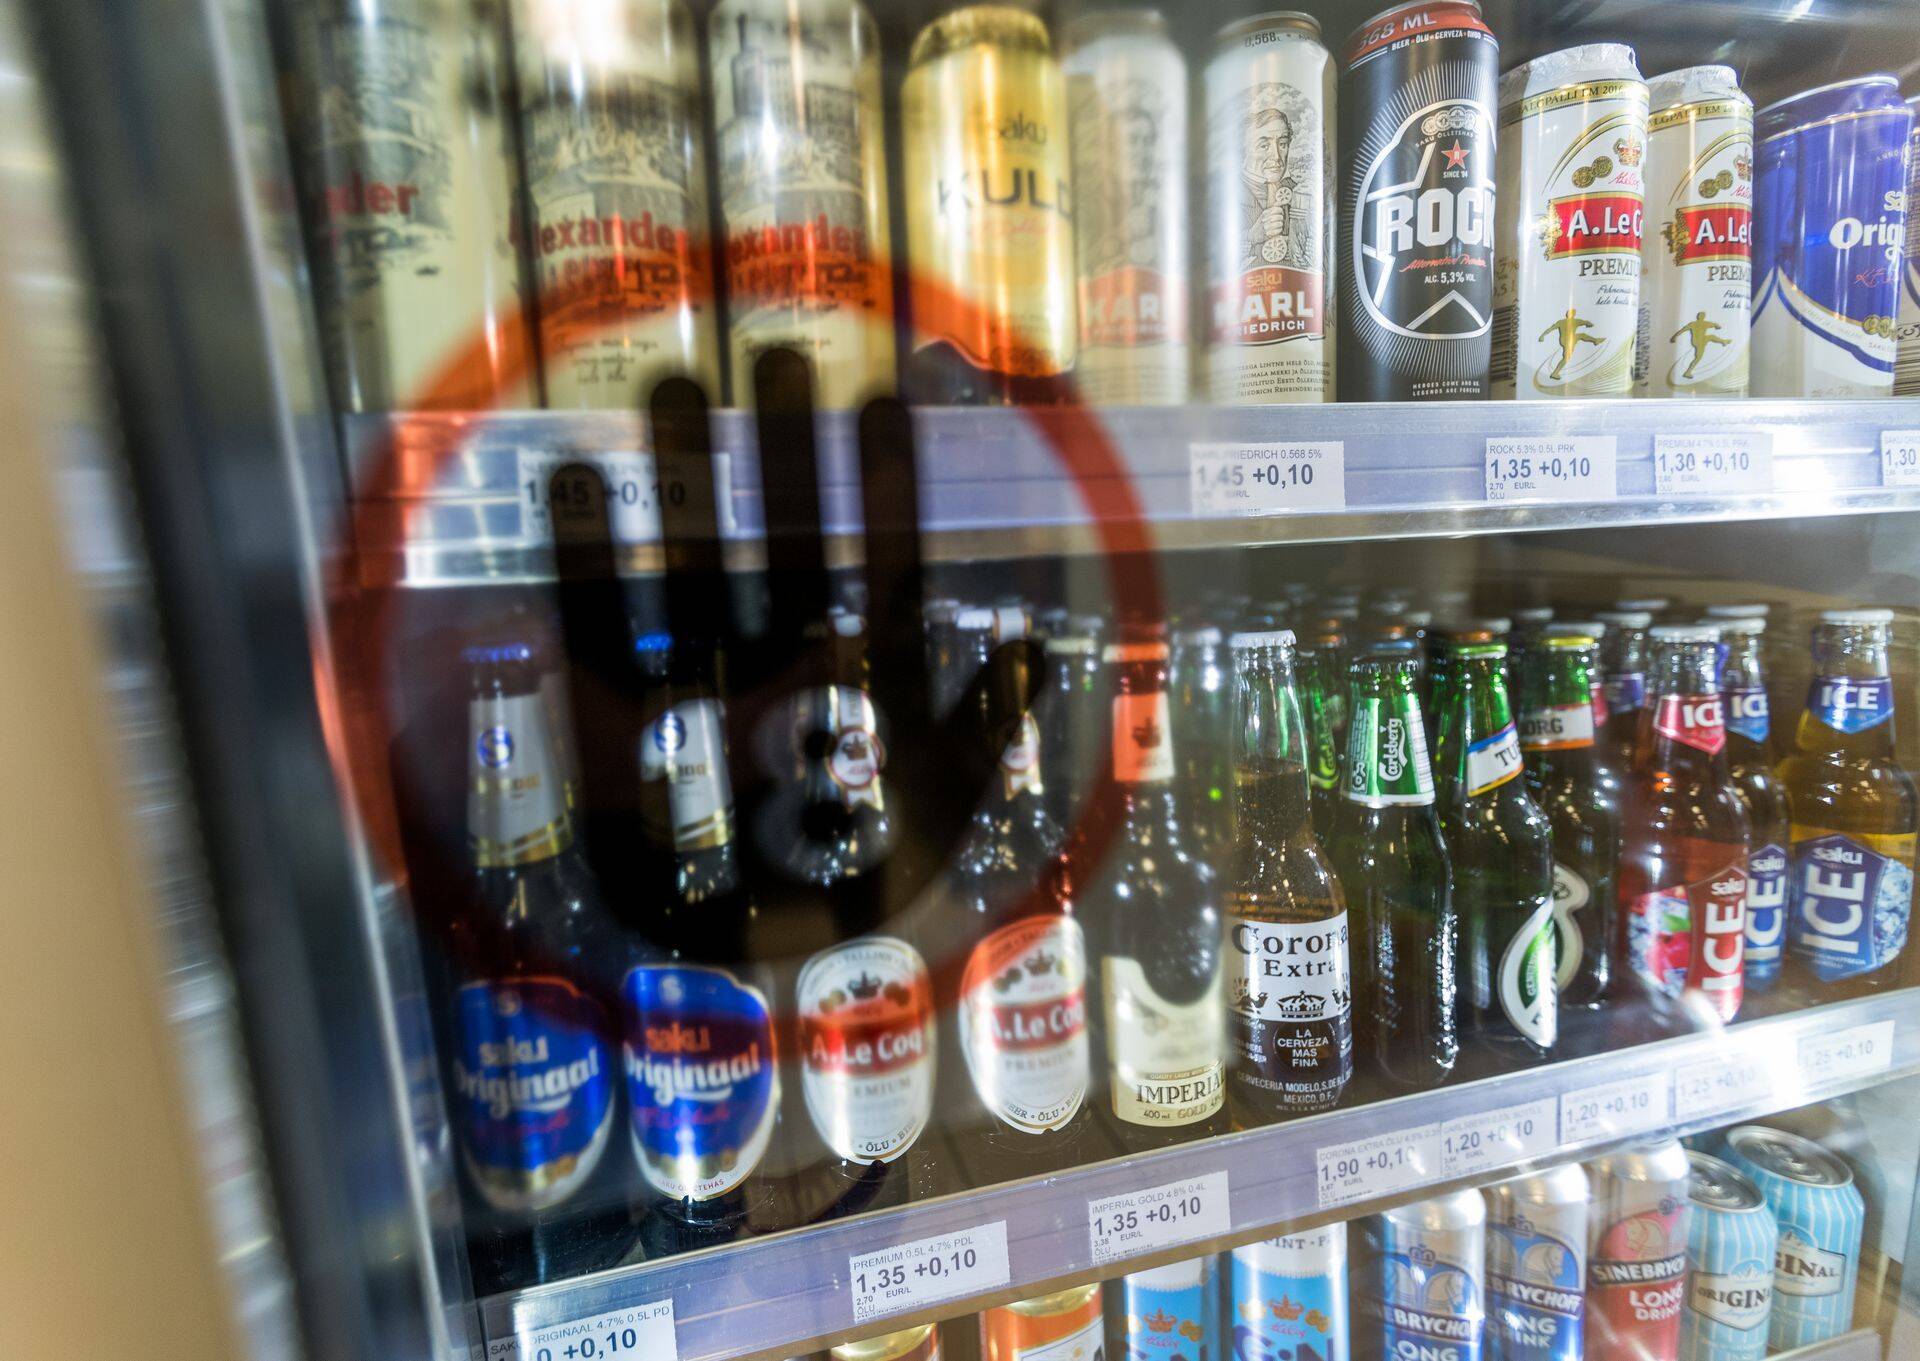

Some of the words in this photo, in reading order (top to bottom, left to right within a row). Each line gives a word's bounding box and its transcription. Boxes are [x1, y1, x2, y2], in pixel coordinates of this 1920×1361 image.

[1403, 11, 1437, 31] ML
[1391, 38, 1410, 51] BEER
[1435, 30, 1463, 40] CERVEZA
[1247, 271, 1282, 287] saku
[1440, 271, 1464, 285] 5,3%
[1214, 291, 1314, 327] ARL
[1281, 449, 1305, 459] 0.568
[1308, 449, 1322, 459] 5%
[1490, 445, 1515, 454] ROCK
[1558, 444, 1575, 453] PRK
[1490, 458, 1532, 481] 1,35
[1539, 457, 1590, 481] +0,10
[1659, 452, 1695, 474] 1,30
[1702, 452, 1750, 474] +0,10
[1252, 463, 1314, 489] +0,10
[1821, 685, 1880, 710] ICE
[1378, 718, 1408, 782] Carlsberg
[1745, 875, 1786, 961] ICE
[1801, 864, 1867, 954] ICE
[1702, 899, 1745, 991] ICE
[1277, 1036, 1330, 1048] CERVEZA
[1296, 1029, 1312, 1039] LA
[1292, 1048, 1318, 1058] MAS
[1292, 1058, 1318, 1067] FINA
[1143, 1109, 1160, 1119] 400
[1177, 1103, 1207, 1119] GOLD
[866, 1140, 889, 1152] ÕLU
[1445, 1131, 1480, 1154] 1,20
[1487, 1119, 1533, 1142] +010
[1320, 1148, 1356, 1161] CORONA
[1358, 1140, 1385, 1153] EXTRA
[1321, 1158, 1359, 1182] 1,90
[1092, 1200, 1136, 1214] IMPERIAL
[1138, 1192, 1164, 1205] GOLD
[1094, 1211, 1138, 1236] 1,35
[1146, 1196, 1201, 1223] +0,10
[1120, 1231, 1143, 1241] EUR/L
[854, 1251, 904, 1271] PREMIUM
[906, 1247, 926, 1258] 0.5L
[928, 1240, 952, 1254] 4.7%
[953, 1235, 974, 1248] PDL
[856, 1265, 906, 1293] 1,35
[914, 1248, 976, 1278] +0,10
[856, 1295, 873, 1305] 2,70
[886, 1287, 912, 1298] EUR/L
[597, 1317, 624, 1330] 4.7%
[627, 1311, 650, 1323] 0.5L
[653, 1305, 670, 1318] PD
[563, 1327, 637, 1361] +0,10
